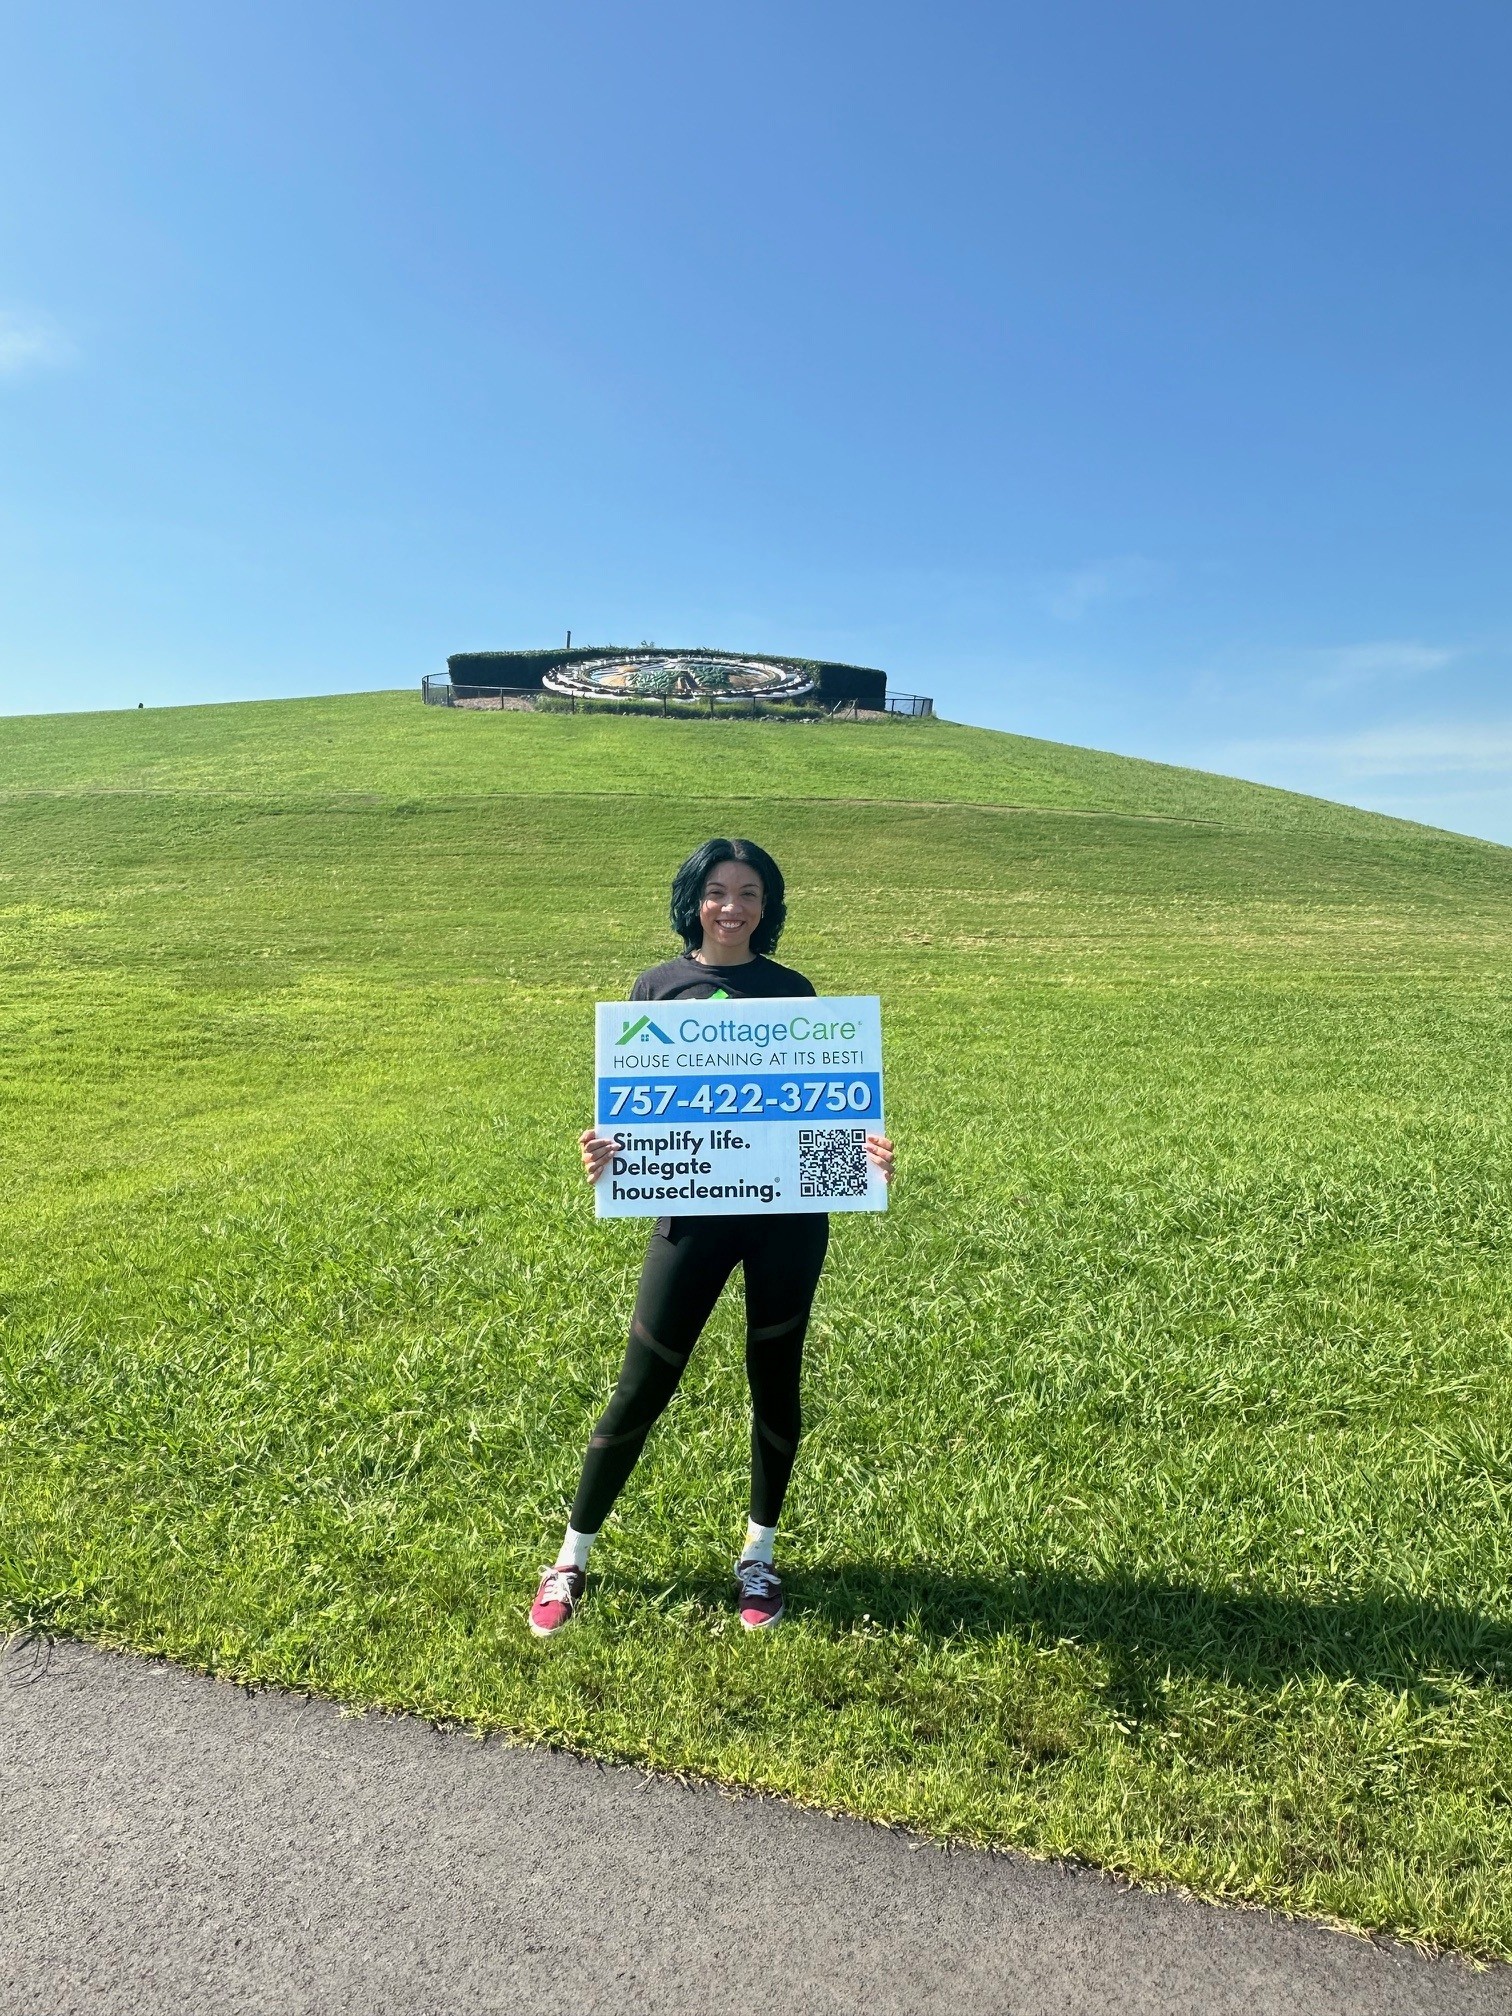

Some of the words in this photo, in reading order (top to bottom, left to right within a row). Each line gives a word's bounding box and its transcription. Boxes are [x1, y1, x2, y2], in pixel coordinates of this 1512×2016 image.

[613, 1054, 670, 1069] HOUSE
[676, 1052, 764, 1068] CLEANING
[769, 1052, 788, 1066] AT
[794, 1051, 816, 1065] ITS
[822, 1050, 864, 1065] BEST!
[609, 1081, 872, 1117] 757-422-3750
[613, 1131, 704, 1155] Simplify
[710, 1130, 751, 1151] life.
[612, 1156, 712, 1181] Delegate
